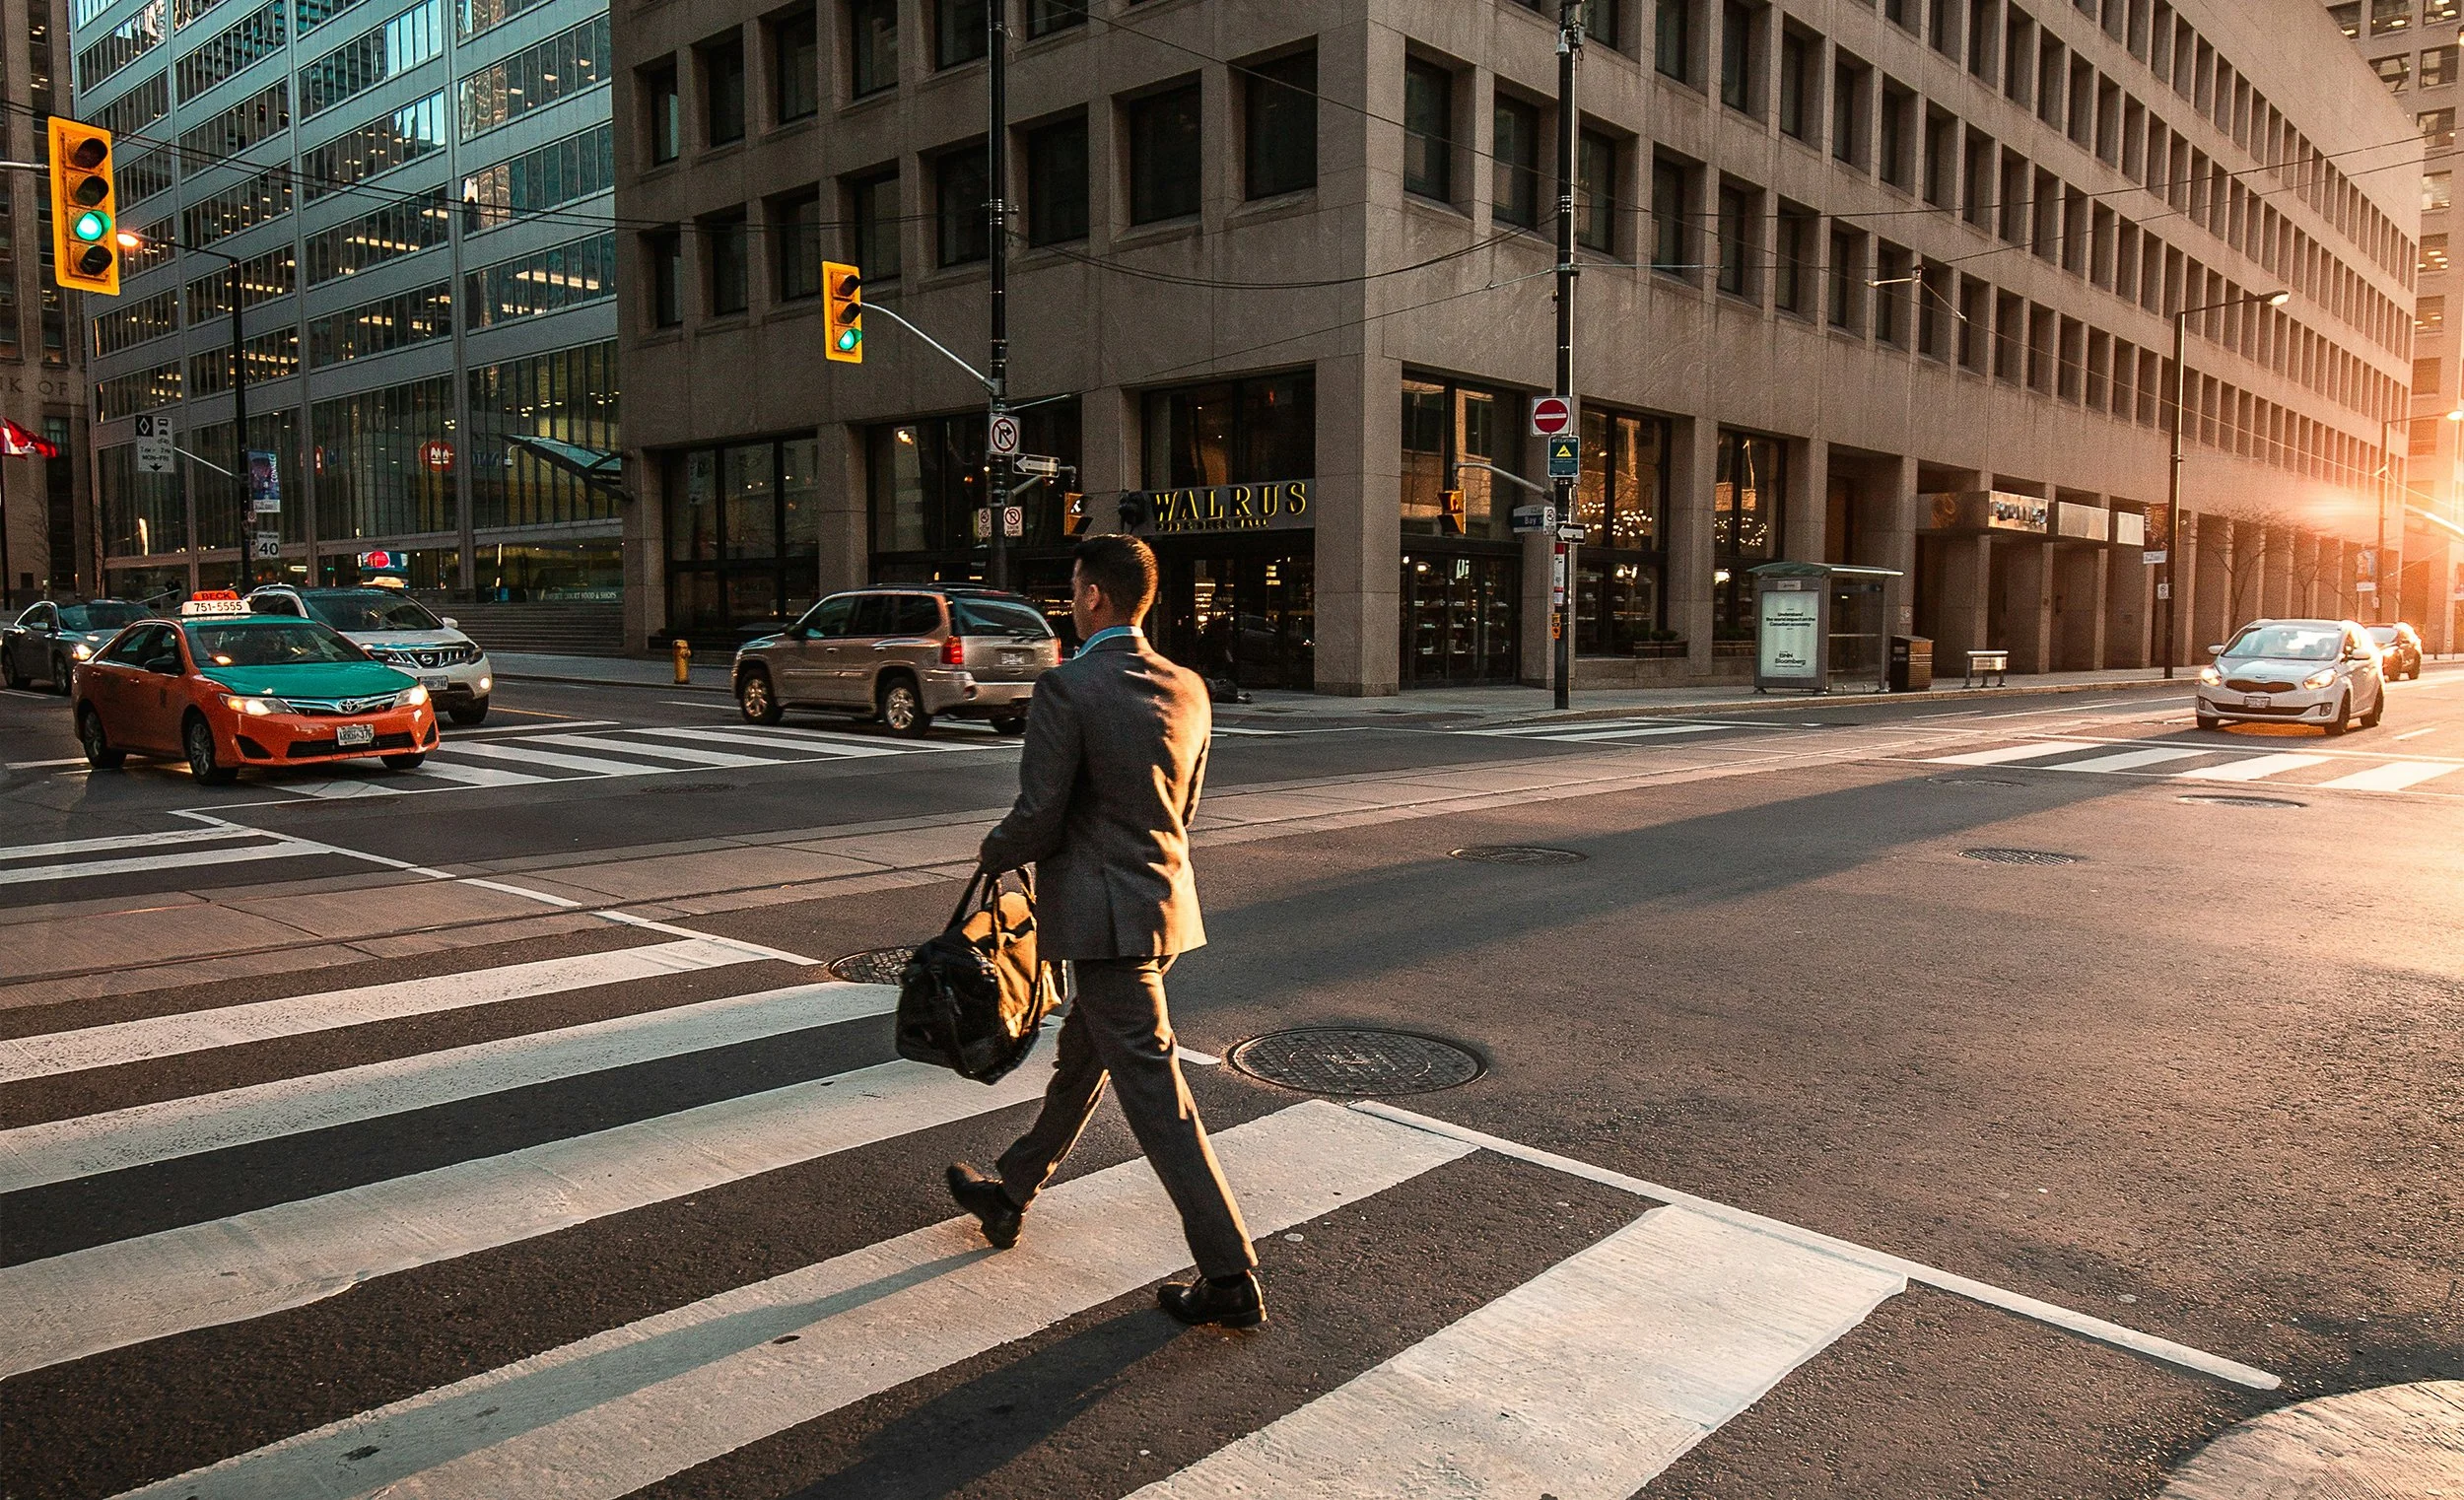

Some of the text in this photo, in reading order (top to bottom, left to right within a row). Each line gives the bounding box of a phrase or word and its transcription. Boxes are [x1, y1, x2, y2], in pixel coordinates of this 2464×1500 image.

[1149, 481, 1307, 522] WALRUS
[1524, 515, 1537, 525] Bay
[259, 542, 279, 556] 40
[194, 601, 242, 612] 751-5555
